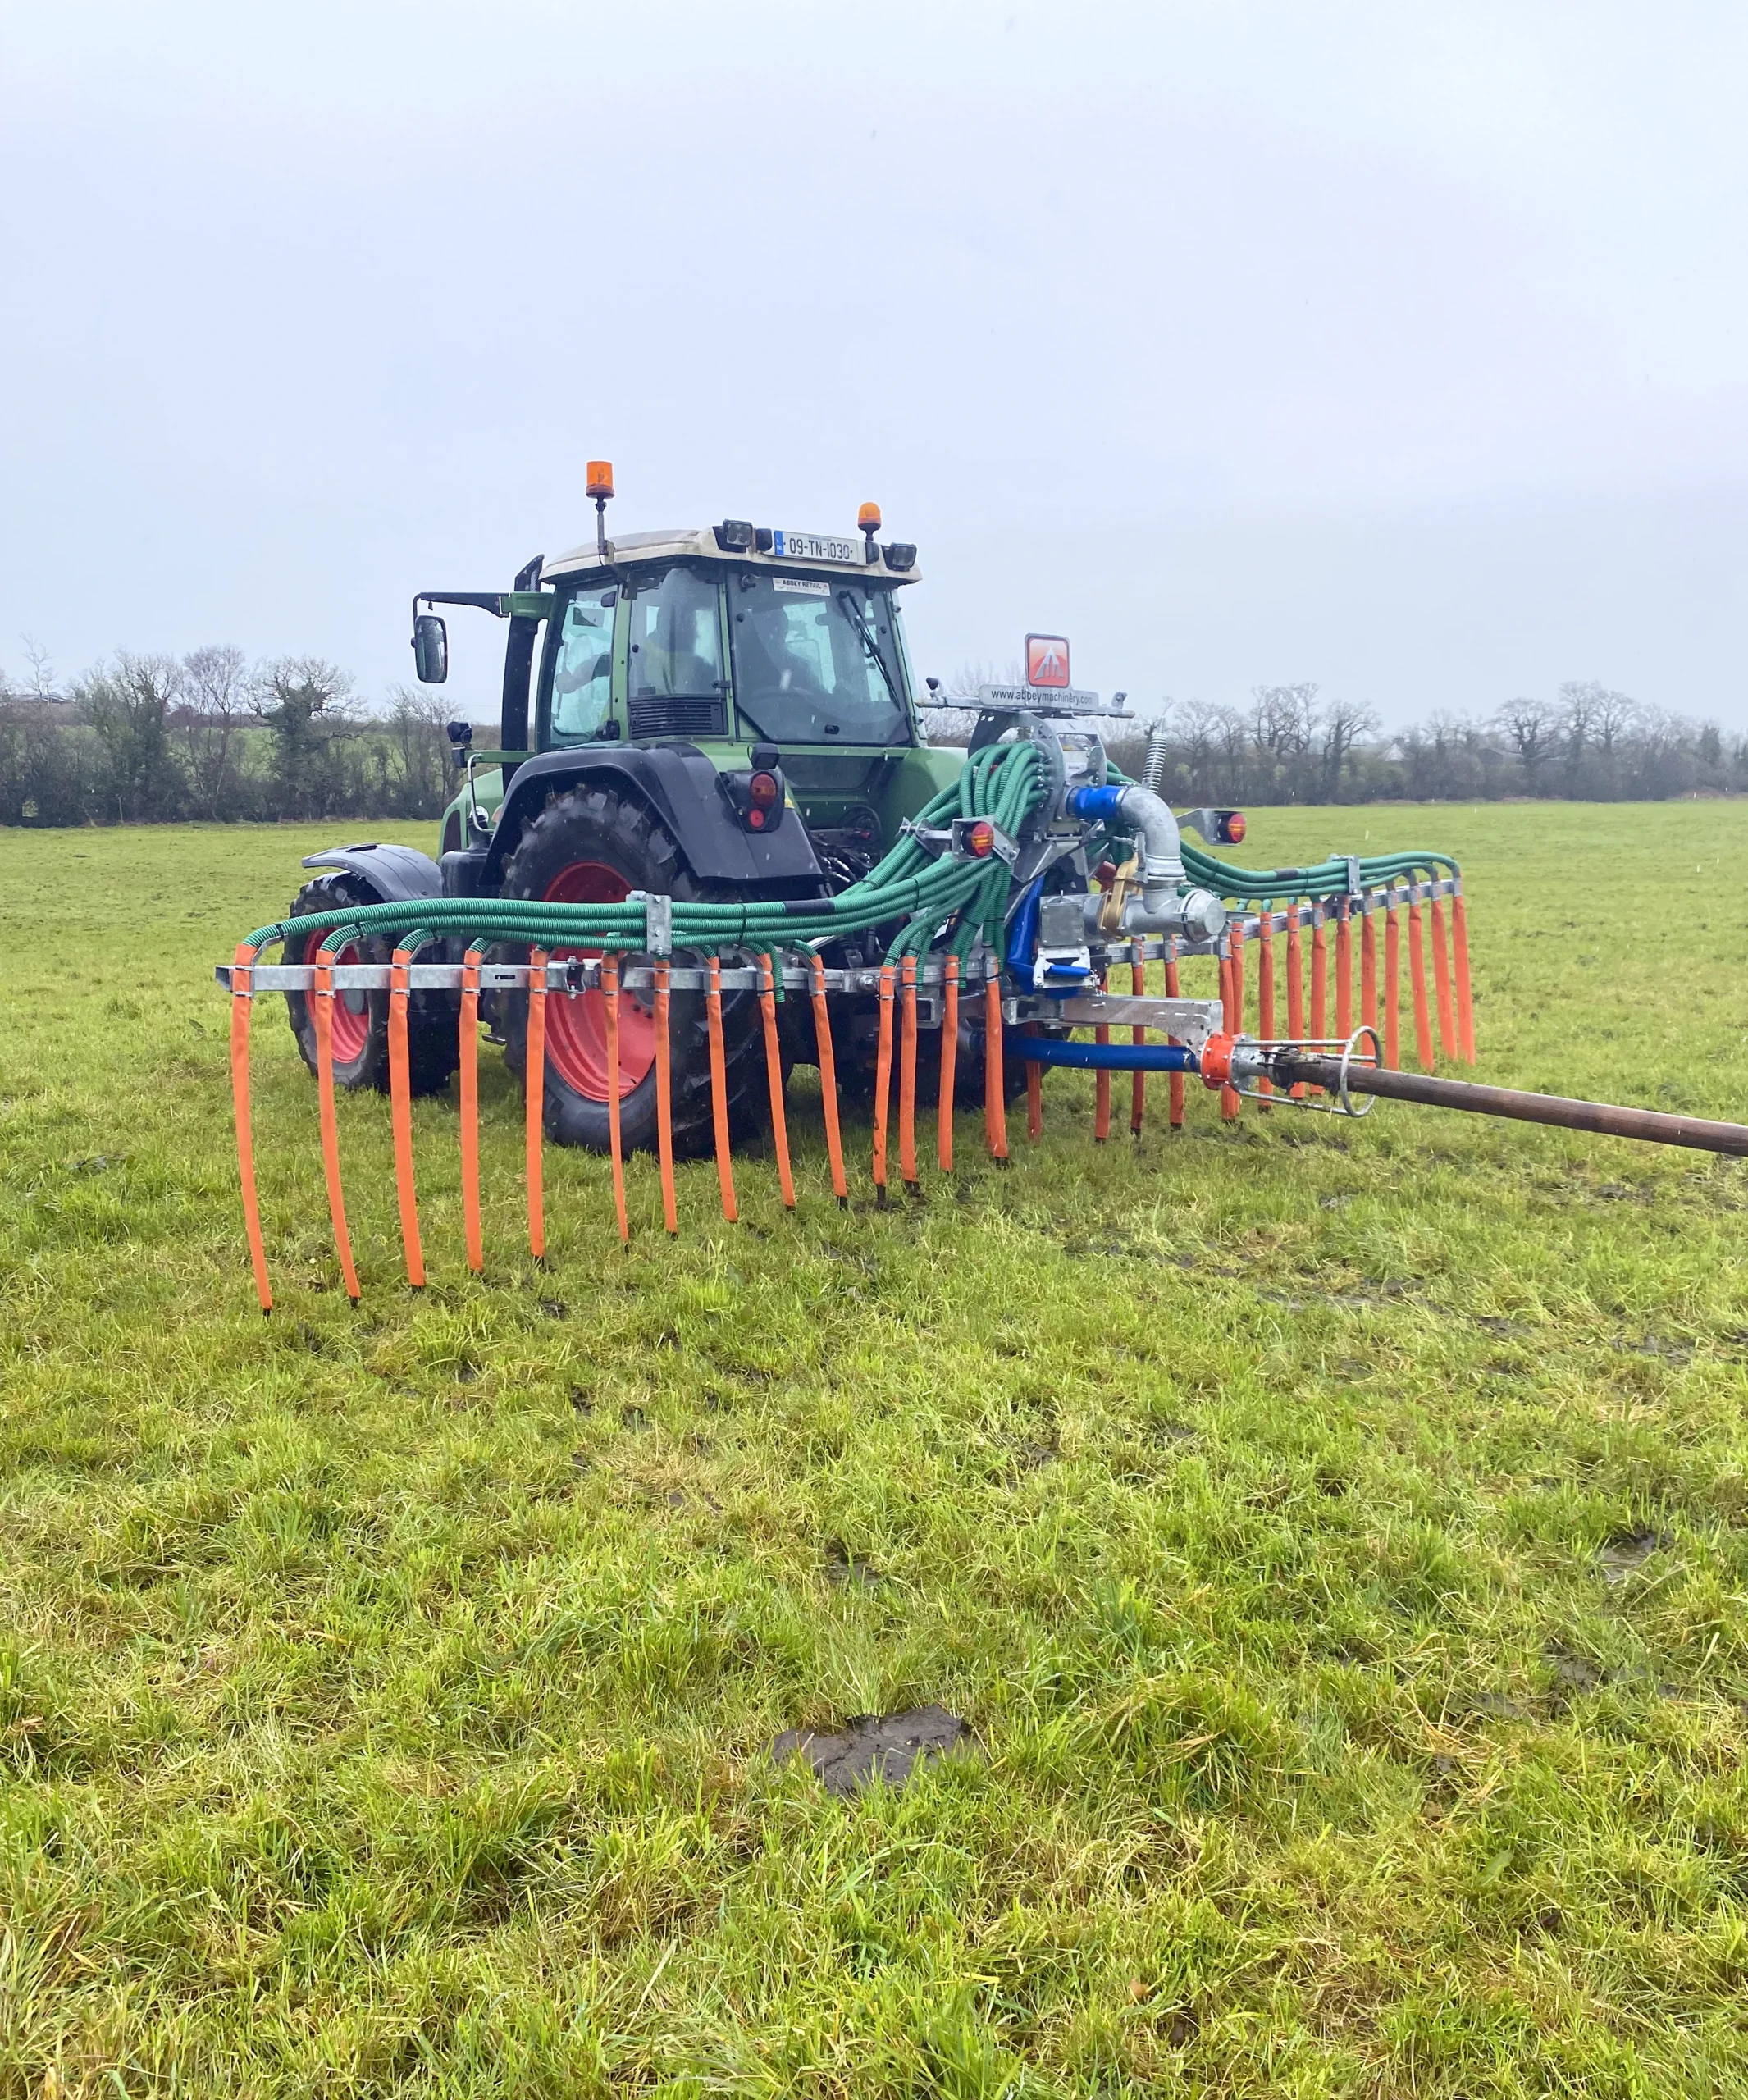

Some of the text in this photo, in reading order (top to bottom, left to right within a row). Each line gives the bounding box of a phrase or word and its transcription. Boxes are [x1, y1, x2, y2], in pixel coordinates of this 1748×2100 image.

[789, 537, 850, 559] 09-TN-1030
[802, 581, 822, 589] RETAIL
[991, 690, 1093, 705] www.abbeymachinery.com
